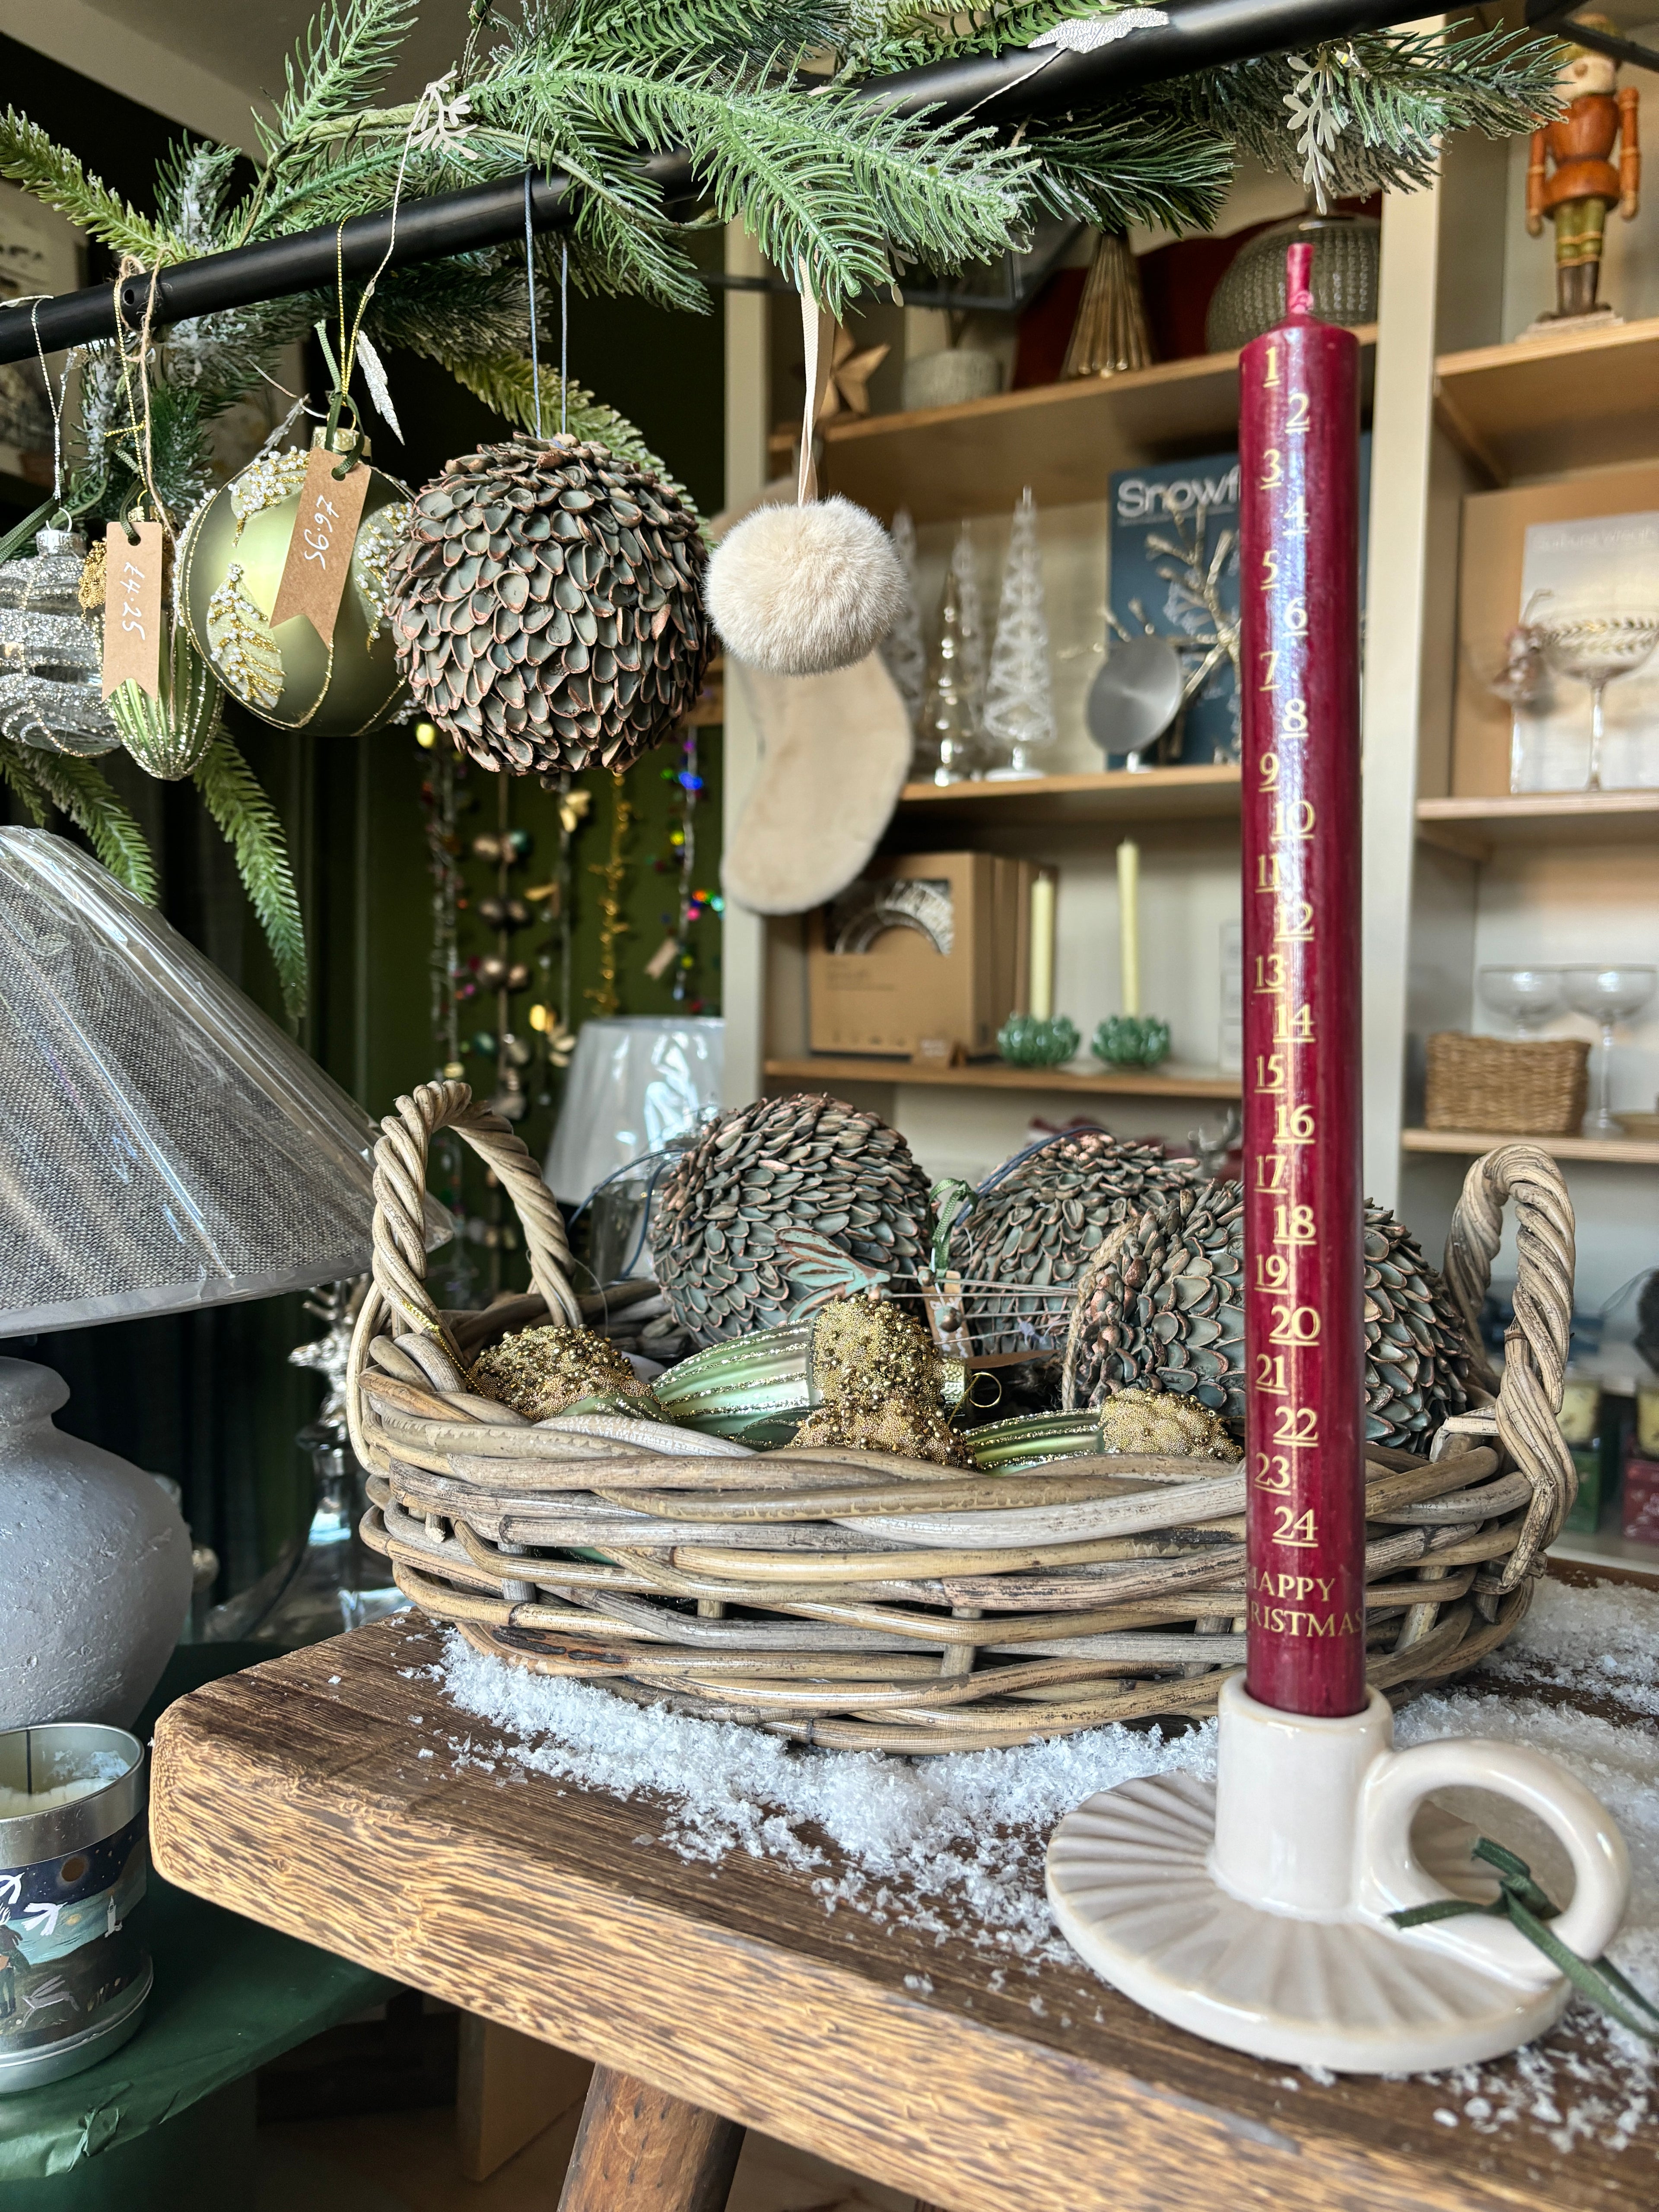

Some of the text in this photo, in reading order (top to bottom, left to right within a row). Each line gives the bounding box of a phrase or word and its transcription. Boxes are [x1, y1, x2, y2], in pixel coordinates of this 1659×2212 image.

[1264, 346, 1278, 382] 1
[1286, 393, 1309, 428] 2
[1261, 448, 1281, 483] 3
[1284, 495, 1308, 529] 4
[304, 495, 340, 570] £6.95
[1262, 550, 1279, 585] 5
[119, 562, 145, 640] £4.25
[1284, 595, 1308, 630] 6
[1259, 651, 1280, 685] 7
[1282, 698, 1308, 732] 8
[1259, 752, 1279, 786] 9
[1273, 800, 1316, 835] 10
[1257, 853, 1281, 887] 11
[1276, 903, 1314, 936] 12
[1255, 953, 1285, 988] 13
[1275, 1004, 1315, 1037] 14
[1255, 1053, 1285, 1088] 15
[1275, 1103, 1315, 1138] 16
[1255, 1154, 1285, 1189] 17
[1274, 1204, 1316, 1239] 18
[1255, 1254, 1288, 1288] 19
[1270, 1305, 1321, 1341] 20
[1256, 1354, 1287, 1389] 21
[1274, 1407, 1318, 1440] 22
[1255, 1452, 1291, 1489] 23
[1273, 1505, 1318, 1541] 24
